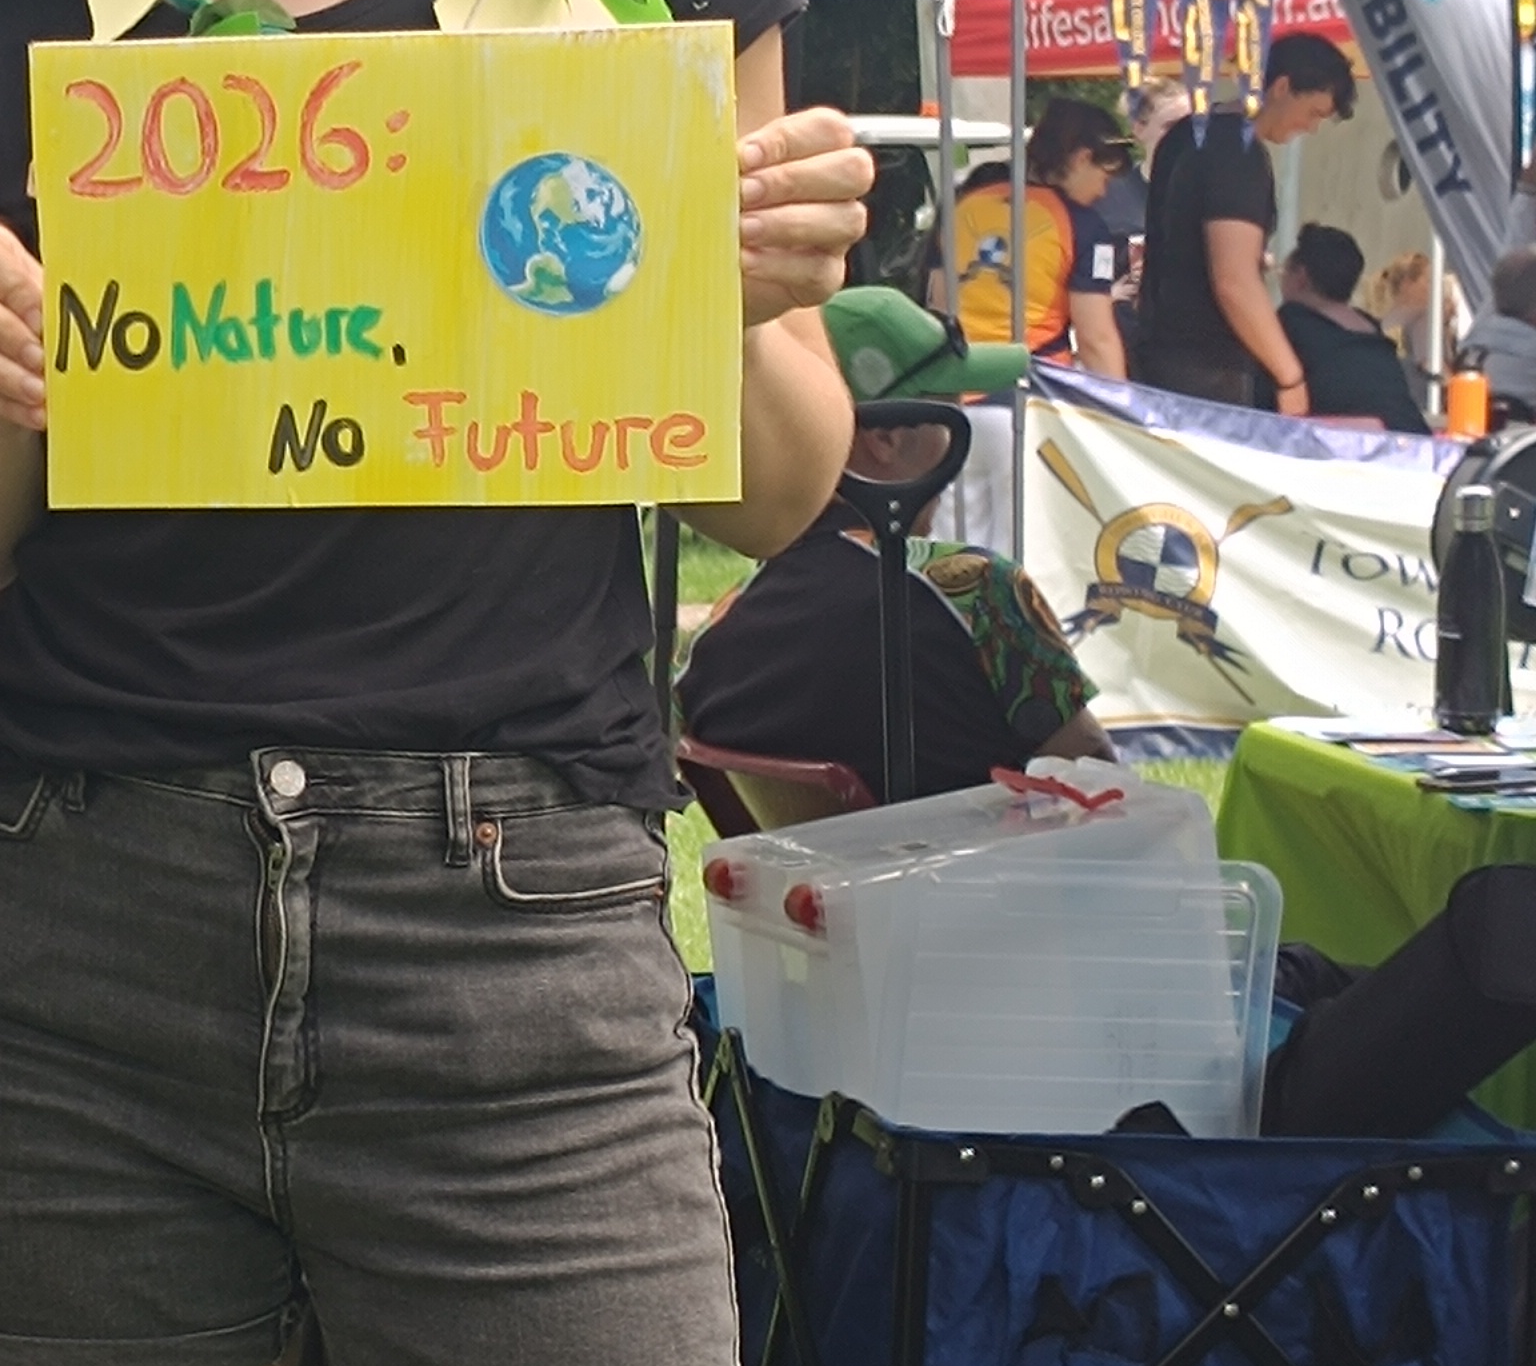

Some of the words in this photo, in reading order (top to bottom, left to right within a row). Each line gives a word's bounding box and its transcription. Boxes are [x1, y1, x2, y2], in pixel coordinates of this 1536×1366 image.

[65, 60, 411, 199] 2026:
[55, 280, 162, 372] No
[267, 399, 365, 475] No
[402, 390, 709, 473] Future
[1310, 537, 1439, 595] TOW
